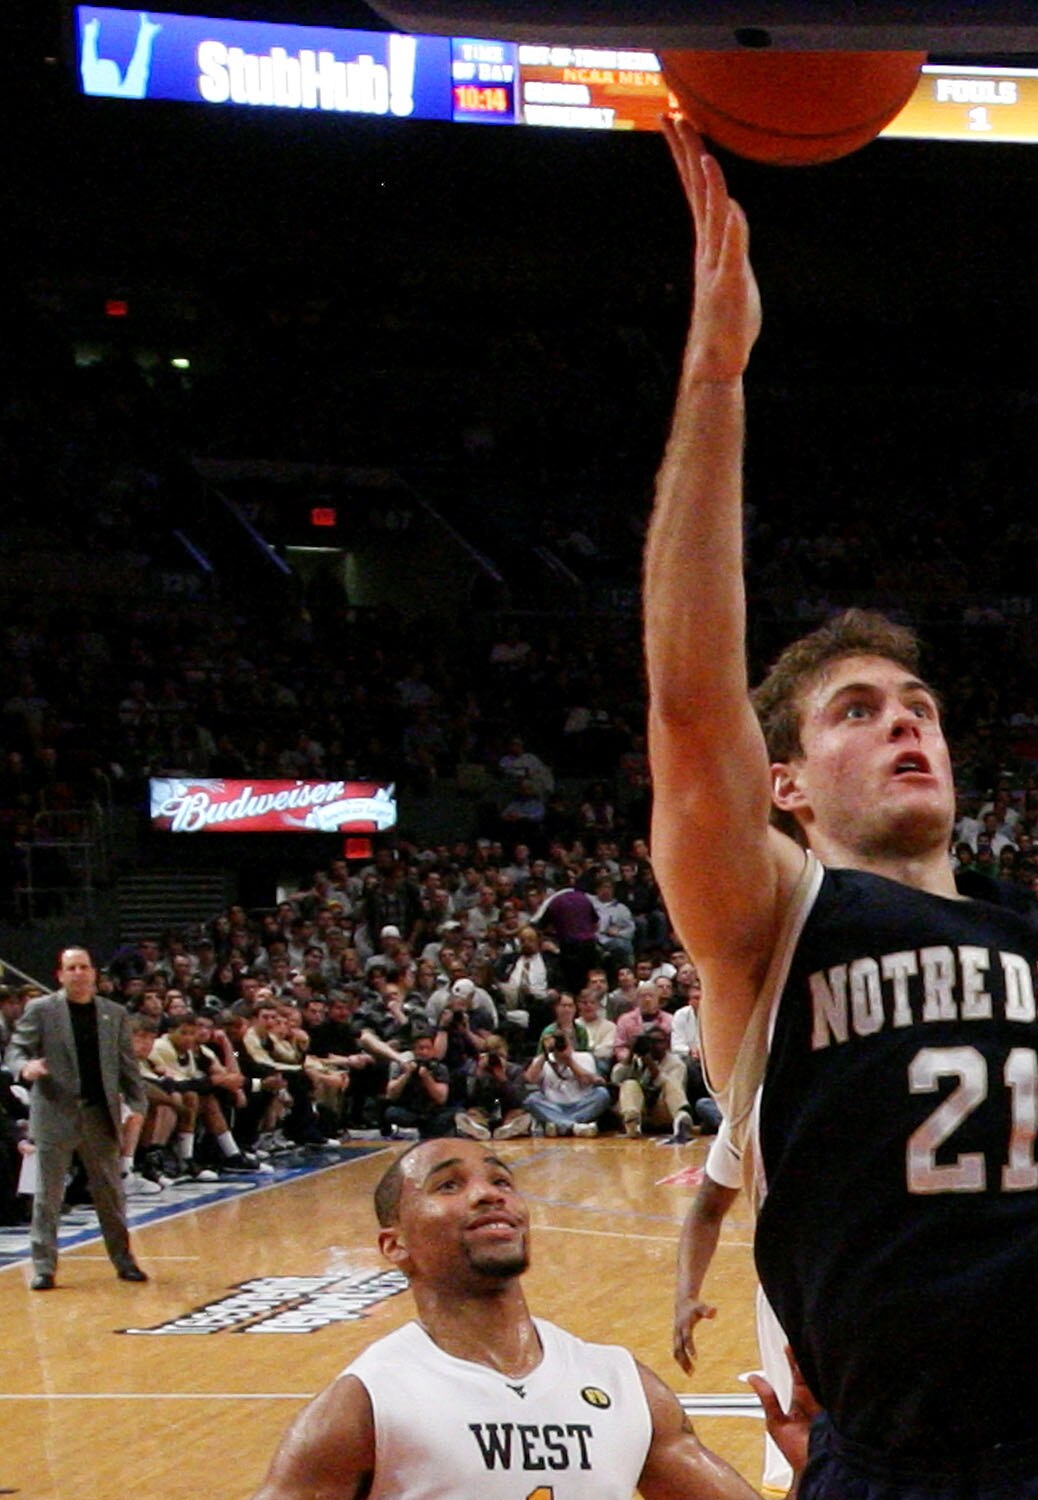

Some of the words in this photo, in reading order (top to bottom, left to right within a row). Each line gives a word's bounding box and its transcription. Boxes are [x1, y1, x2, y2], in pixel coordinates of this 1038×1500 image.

[198, 34, 416, 116] StubHub!
[563, 68, 614, 83] NCAA
[936, 79, 1017, 104] FOULS
[456, 86, 507, 111] 10:14
[968, 106, 991, 131] 1
[160, 780, 345, 831] Budweiser
[808, 944, 993, 1051] NOTRE
[468, 1423, 593, 1470] WEST
